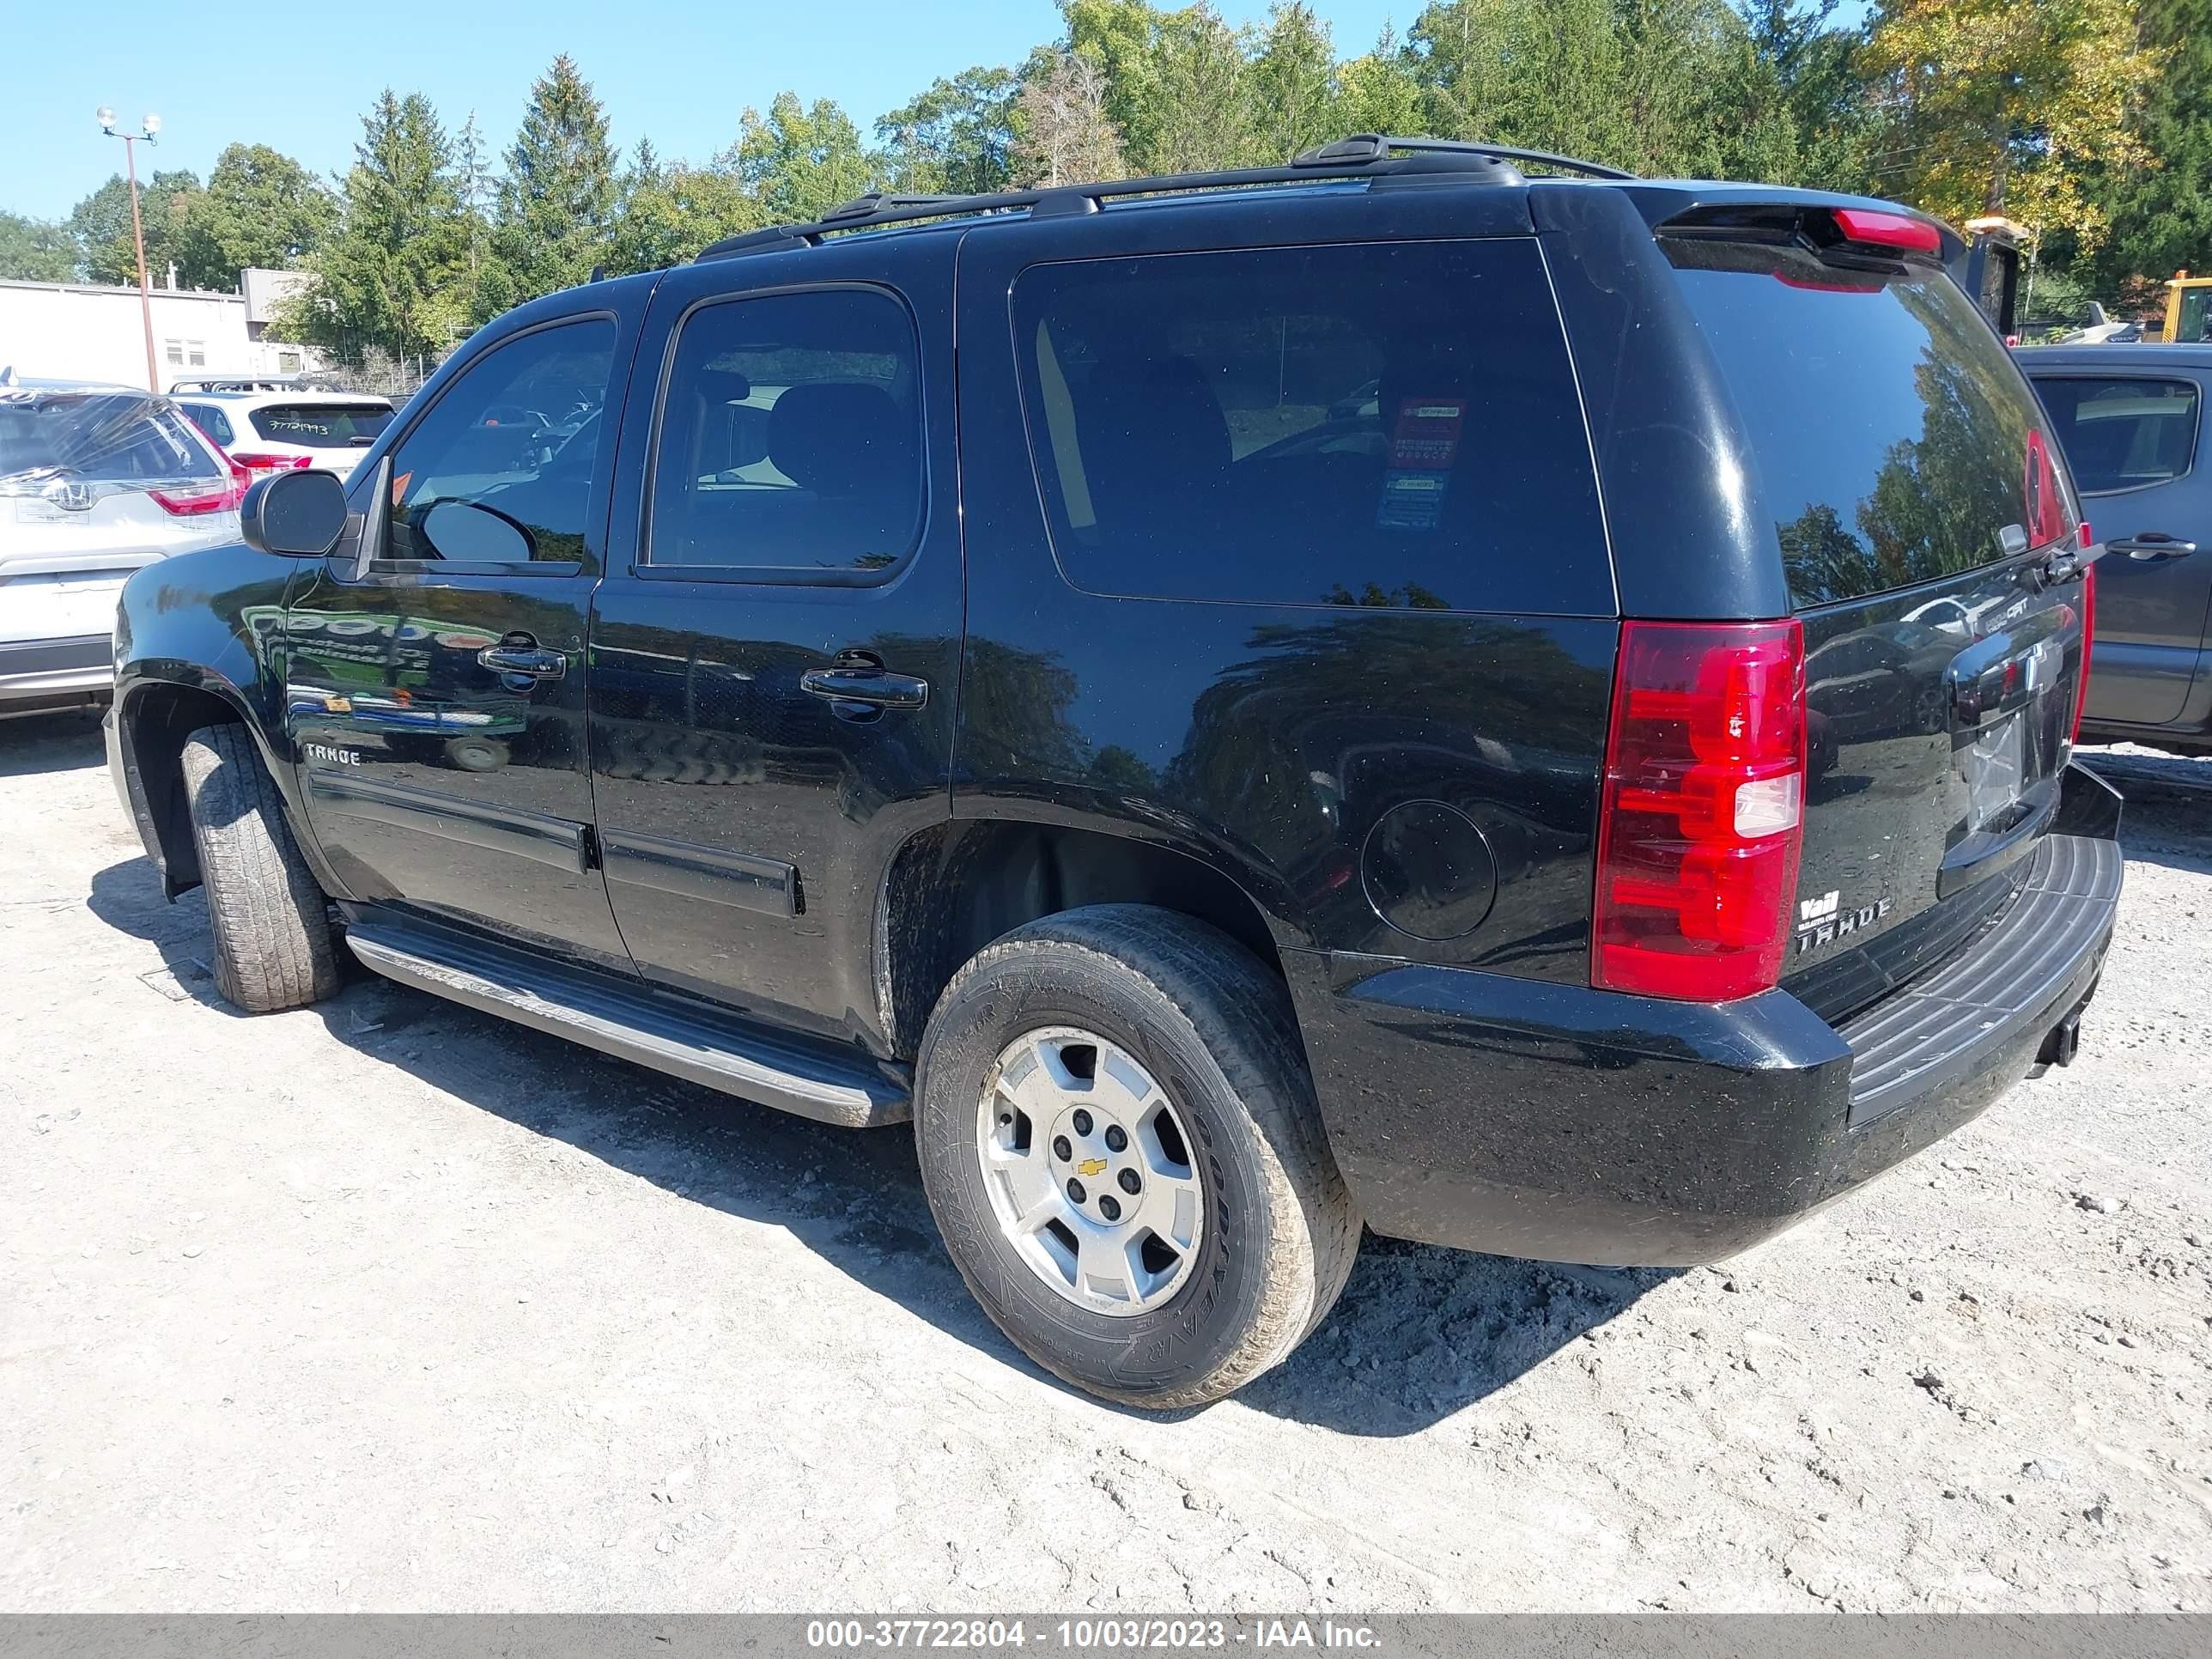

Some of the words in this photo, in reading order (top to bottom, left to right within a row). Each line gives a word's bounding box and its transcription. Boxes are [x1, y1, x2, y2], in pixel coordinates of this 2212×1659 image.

[268, 420, 329, 435] 37724993
[306, 743, 361, 766] TAHOE
[1801, 890, 1839, 921] Vail
[1794, 896, 1890, 956] TAHOE
[1149, 1073, 1230, 1363] GOODYEAR
